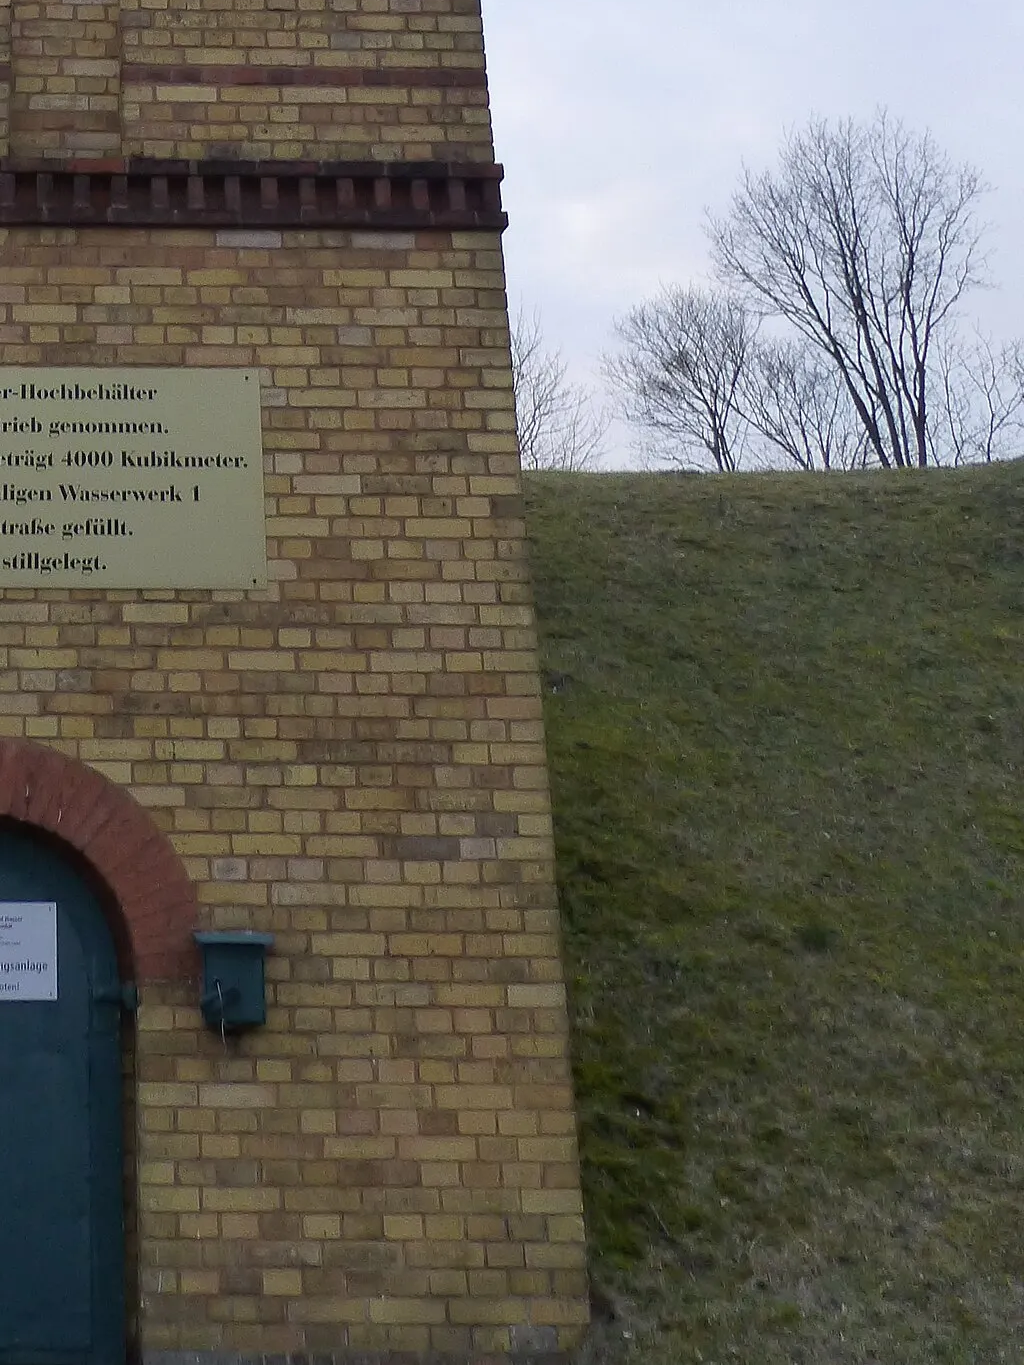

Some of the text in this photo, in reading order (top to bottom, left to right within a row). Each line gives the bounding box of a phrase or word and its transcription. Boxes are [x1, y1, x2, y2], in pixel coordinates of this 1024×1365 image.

[48, 419, 169, 438] genommen.
[60, 449, 114, 468] 4000
[120, 449, 248, 469] Kubikmeter.
[58, 483, 183, 503] Wasserwerk
[191, 484, 201, 503] 1
[61, 517, 134, 541] gefüllt.
[2, 551, 108, 575] stillgelegt.
